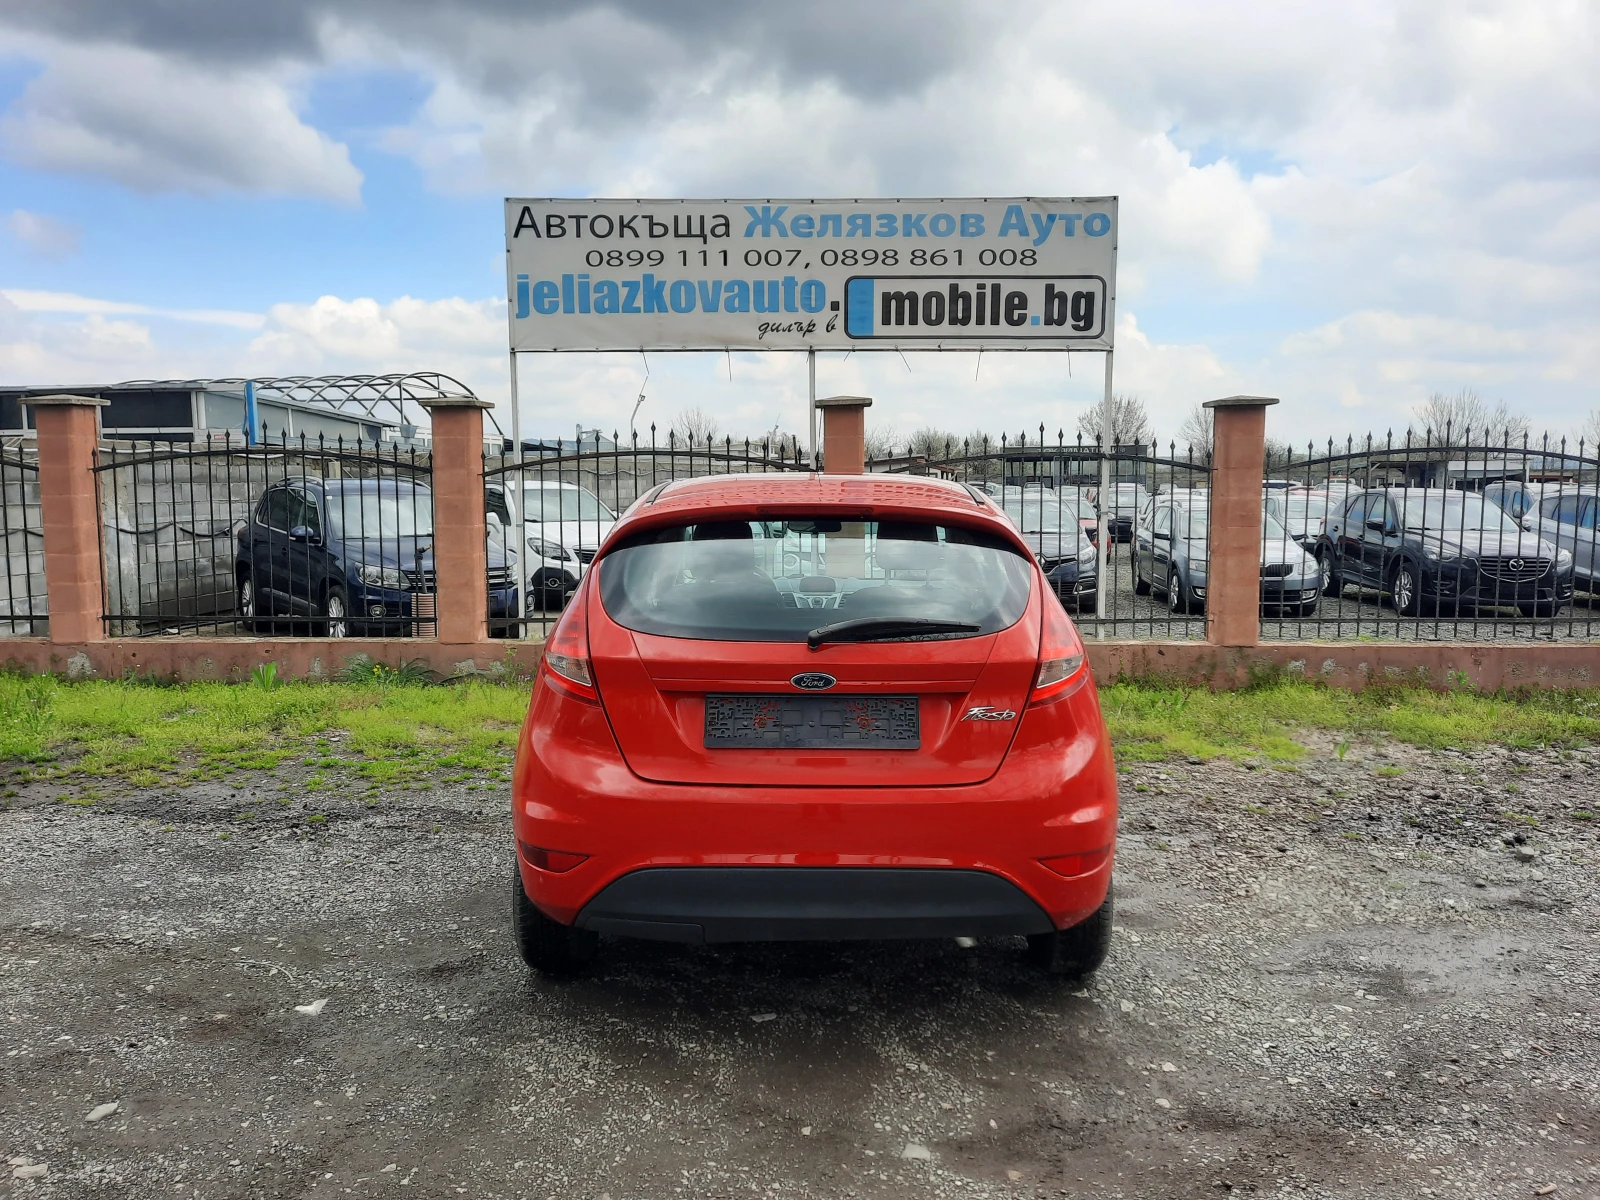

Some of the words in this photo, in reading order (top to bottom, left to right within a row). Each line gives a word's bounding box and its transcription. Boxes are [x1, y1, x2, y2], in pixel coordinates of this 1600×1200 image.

[513, 205, 731, 244] Автокъща
[743, 205, 985, 238] Желязков
[998, 204, 1111, 247] Ауто
[585, 249, 665, 267] 0899
[677, 249, 728, 267] 111
[743, 249, 811, 269] 007,
[820, 248, 900, 267] 0898
[909, 248, 963, 267] 861
[978, 248, 1038, 267] 008
[881, 283, 1096, 332] mobile.bg
[758, 319, 817, 340] дилър
[800, 676, 826, 687] Ford
[960, 706, 1017, 722] Fiesta
